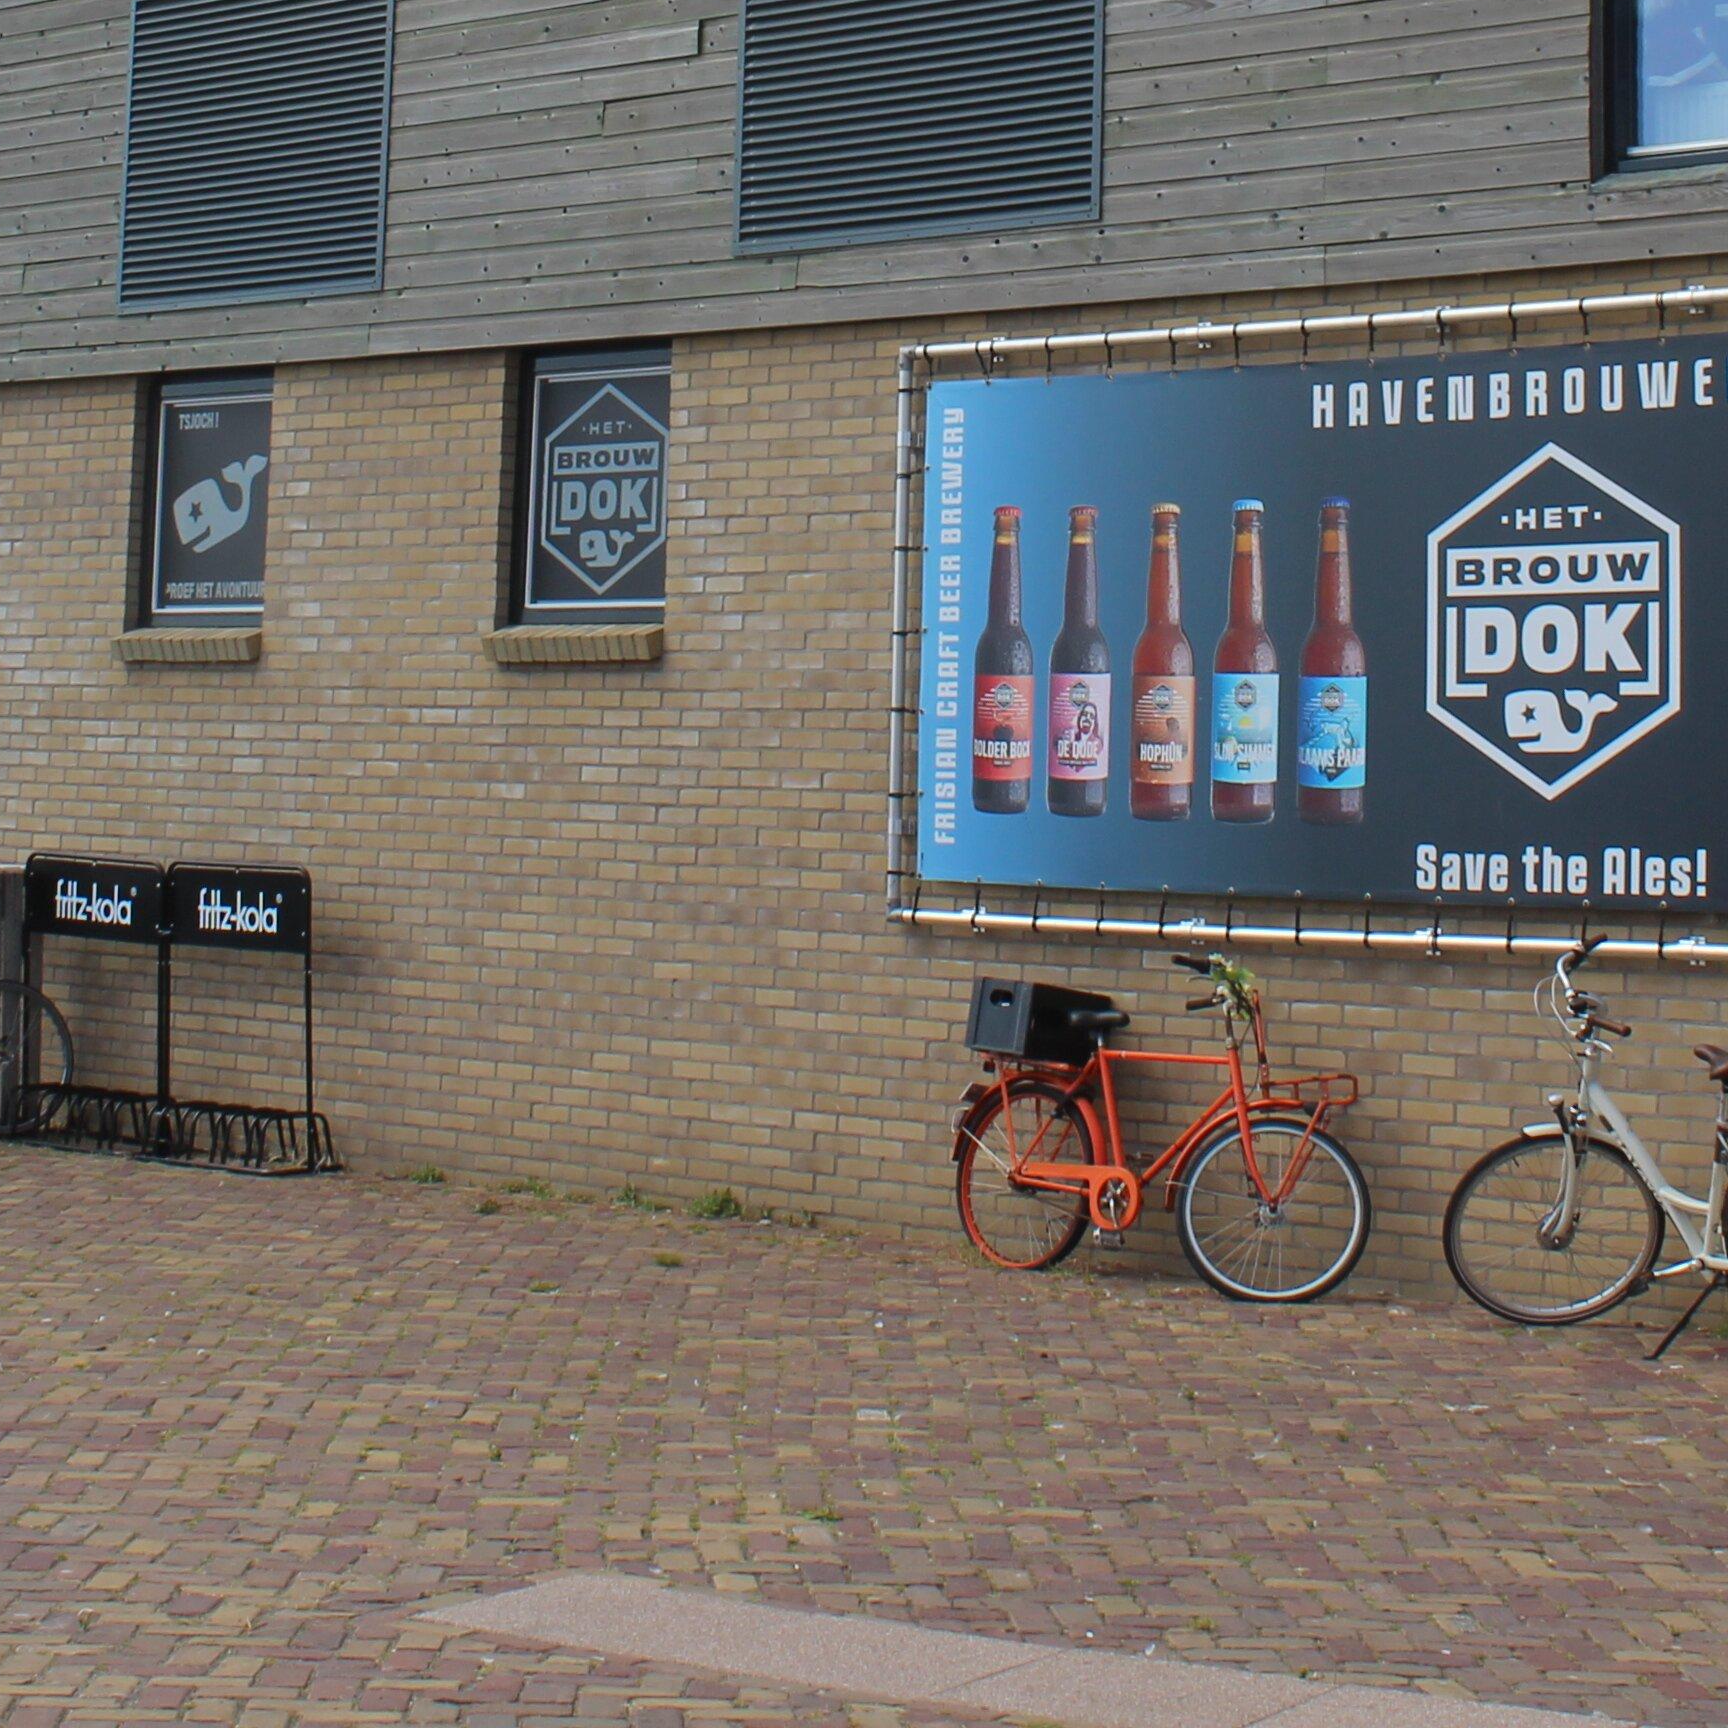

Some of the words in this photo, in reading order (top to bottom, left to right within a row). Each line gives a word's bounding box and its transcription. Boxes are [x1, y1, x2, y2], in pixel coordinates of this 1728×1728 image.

[589, 421, 626, 435] HET
[557, 448, 655, 470] BROUW
[940, 407, 964, 544] BREWERY
[560, 477, 649, 522] DOK
[1515, 506, 1589, 531] HET
[196, 582, 214, 599] HET
[939, 555, 961, 621] BEER
[1456, 552, 1650, 587] BROUW
[1464, 603, 1643, 674] DOK
[936, 631, 959, 717] CRAFT
[1058, 739, 1071, 759] DE
[934, 728, 957, 844] FRISIAN
[1416, 844, 1509, 892] Save
[1522, 845, 1588, 895] the
[1603, 847, 1707, 897] Ales!
